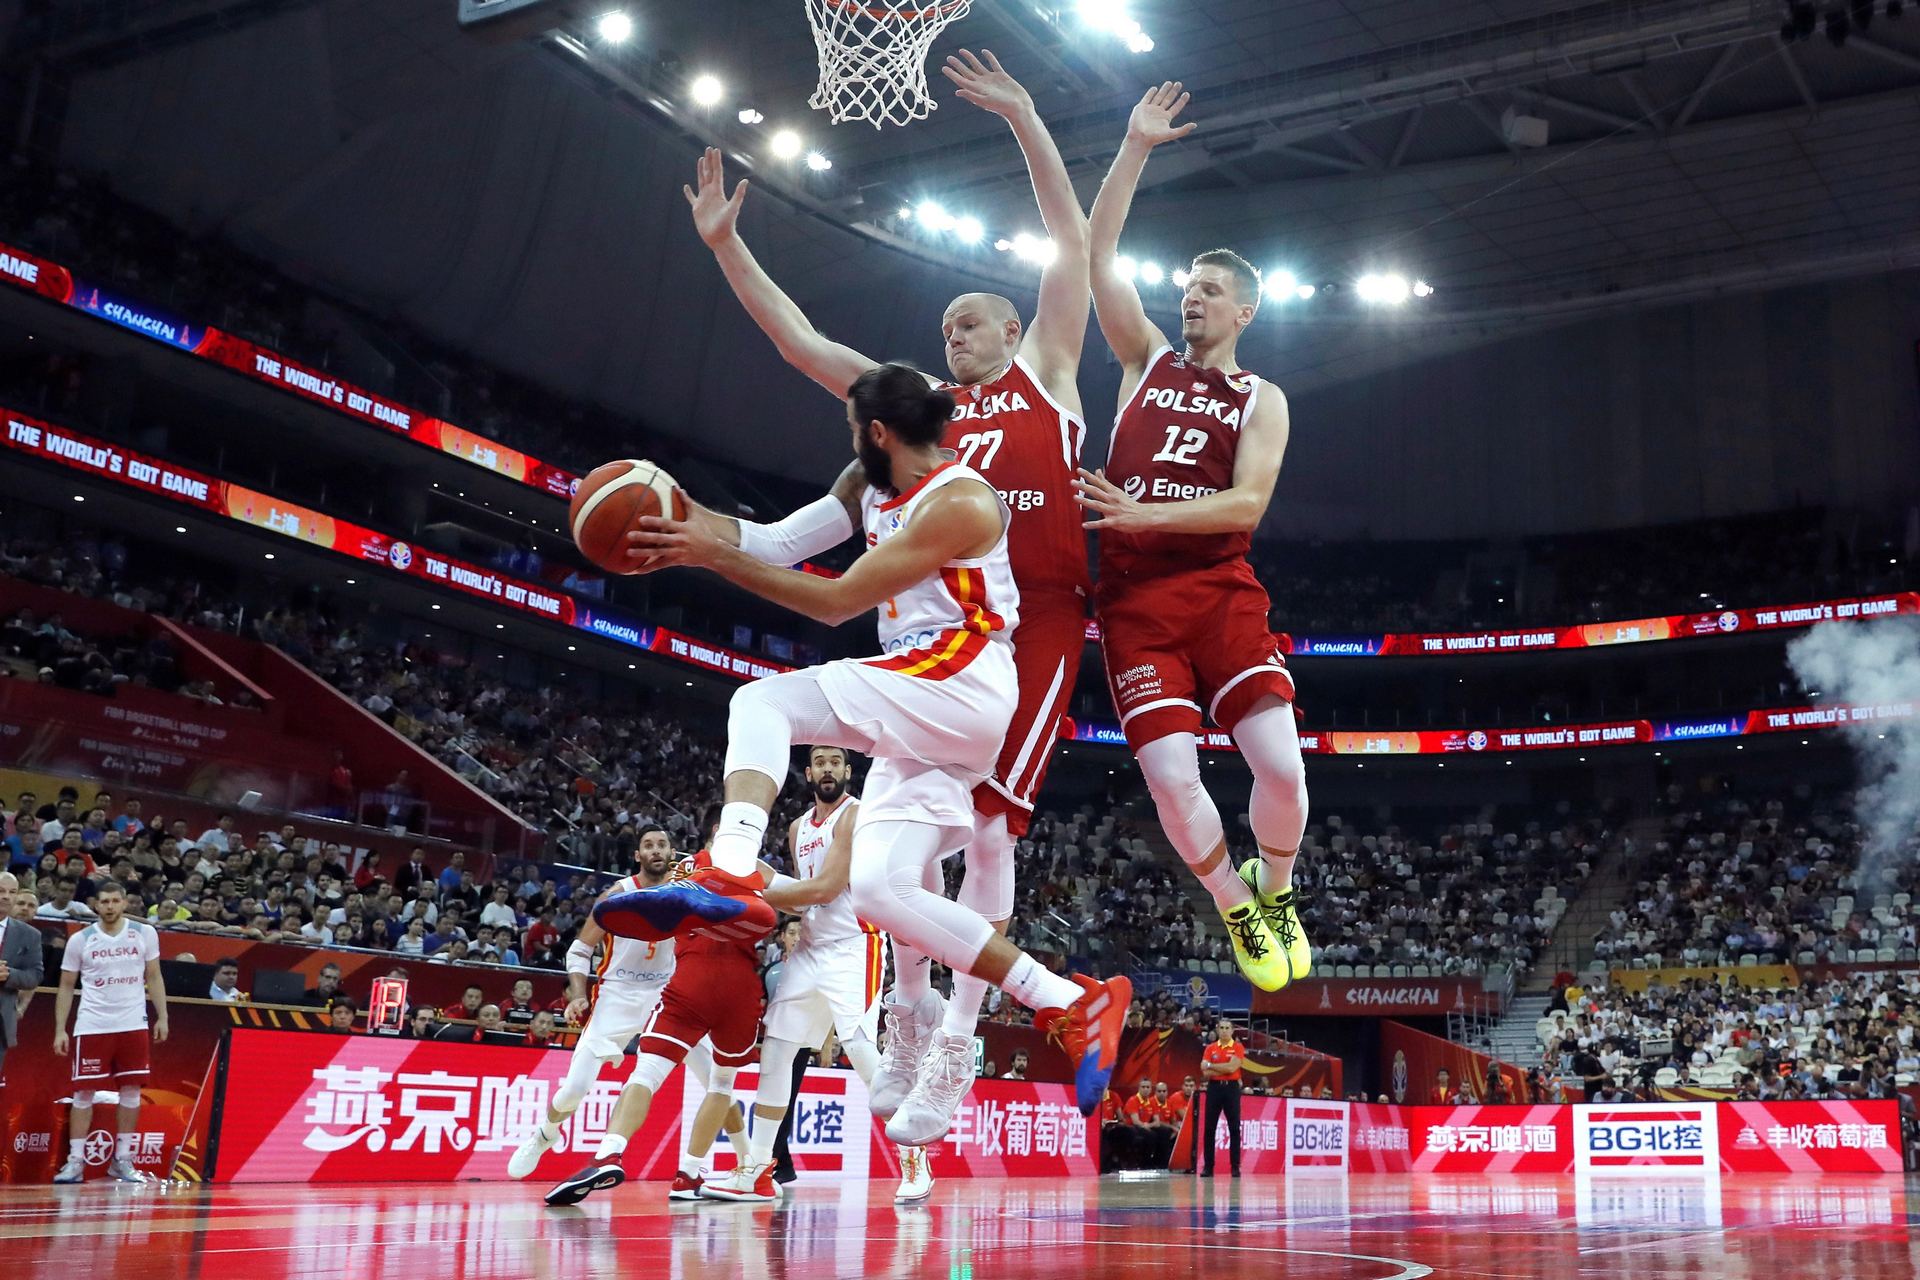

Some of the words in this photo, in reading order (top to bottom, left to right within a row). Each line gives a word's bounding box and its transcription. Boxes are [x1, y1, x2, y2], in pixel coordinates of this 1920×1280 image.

[0, 253, 38, 283] AME
[103, 302, 176, 340] SHANGHAI
[256, 354, 281, 378] THE
[284, 366, 344, 403] WORLD'S
[347, 392, 373, 414] GOT
[373, 402, 411, 430] GAME
[952, 391, 1030, 422] OLSKA
[1142, 388, 1241, 431] POLSKA
[468, 444, 497, 469] 上海
[958, 429, 1004, 470] 77
[1151, 425, 1209, 465] 12
[8, 420, 41, 447] THE
[46, 433, 123, 473] WORLD'S
[128, 460, 160, 484] GOT
[162, 471, 208, 501] GAME
[1000, 489, 1044, 511] erga
[1152, 478, 1218, 500] Ener
[264, 508, 300, 536] 上海
[426, 557, 448, 578] THE
[451, 567, 502, 596] WORLD'S
[506, 584, 528, 603] GOT
[528, 594, 560, 614] GAME
[1756, 613, 1777, 625] THE
[1780, 604, 1832, 622] WORLD'S
[1837, 604, 1860, 617] GOT
[1862, 600, 1898, 614] GAME
[594, 618, 639, 642] SHANGHAI
[1423, 638, 1443, 650] THE
[1446, 634, 1495, 649] WORLD'S
[1500, 636, 1522, 648] GOT
[1523, 633, 1555, 646] GAME
[1613, 627, 1640, 643] 上海
[671, 638, 688, 655] THE
[690, 643, 730, 669] WORLD'S
[732, 659, 750, 675] GOT
[1313, 643, 1363, 653] SHANGHAI
[104, 706, 125, 719] FIBA
[180, 721, 210, 737] WORLD
[1768, 714, 1790, 727] THE
[1793, 707, 1847, 725] WORLD'S
[1852, 706, 1874, 720] GOT
[1876, 703, 1912, 718] GAME
[1096, 730, 1128, 742] SHAN
[1500, 733, 1521, 746] THE
[1524, 729, 1575, 744] WORLD'S
[1579, 729, 1602, 742] GOT
[1603, 726, 1636, 740] GAME
[1674, 723, 1727, 736] SHANGHAI
[1300, 737, 1318, 748] ME
[1362, 738, 1390, 753] 上海
[92, 946, 139, 959] POLSKA
[107, 976, 139, 985] Energa
[1346, 986, 1439, 1005] SHANGHAI
[943, 1099, 1087, 1157] 丰收葡萄酒
[1293, 1123, 1343, 1150] BG北控
[1426, 1125, 1556, 1152] 燕京啤酒
[1589, 1124, 1702, 1151] BG北控
[1767, 1123, 1887, 1149] 丰收葡萄酒
[131, 1154, 162, 1164] NUCIA
